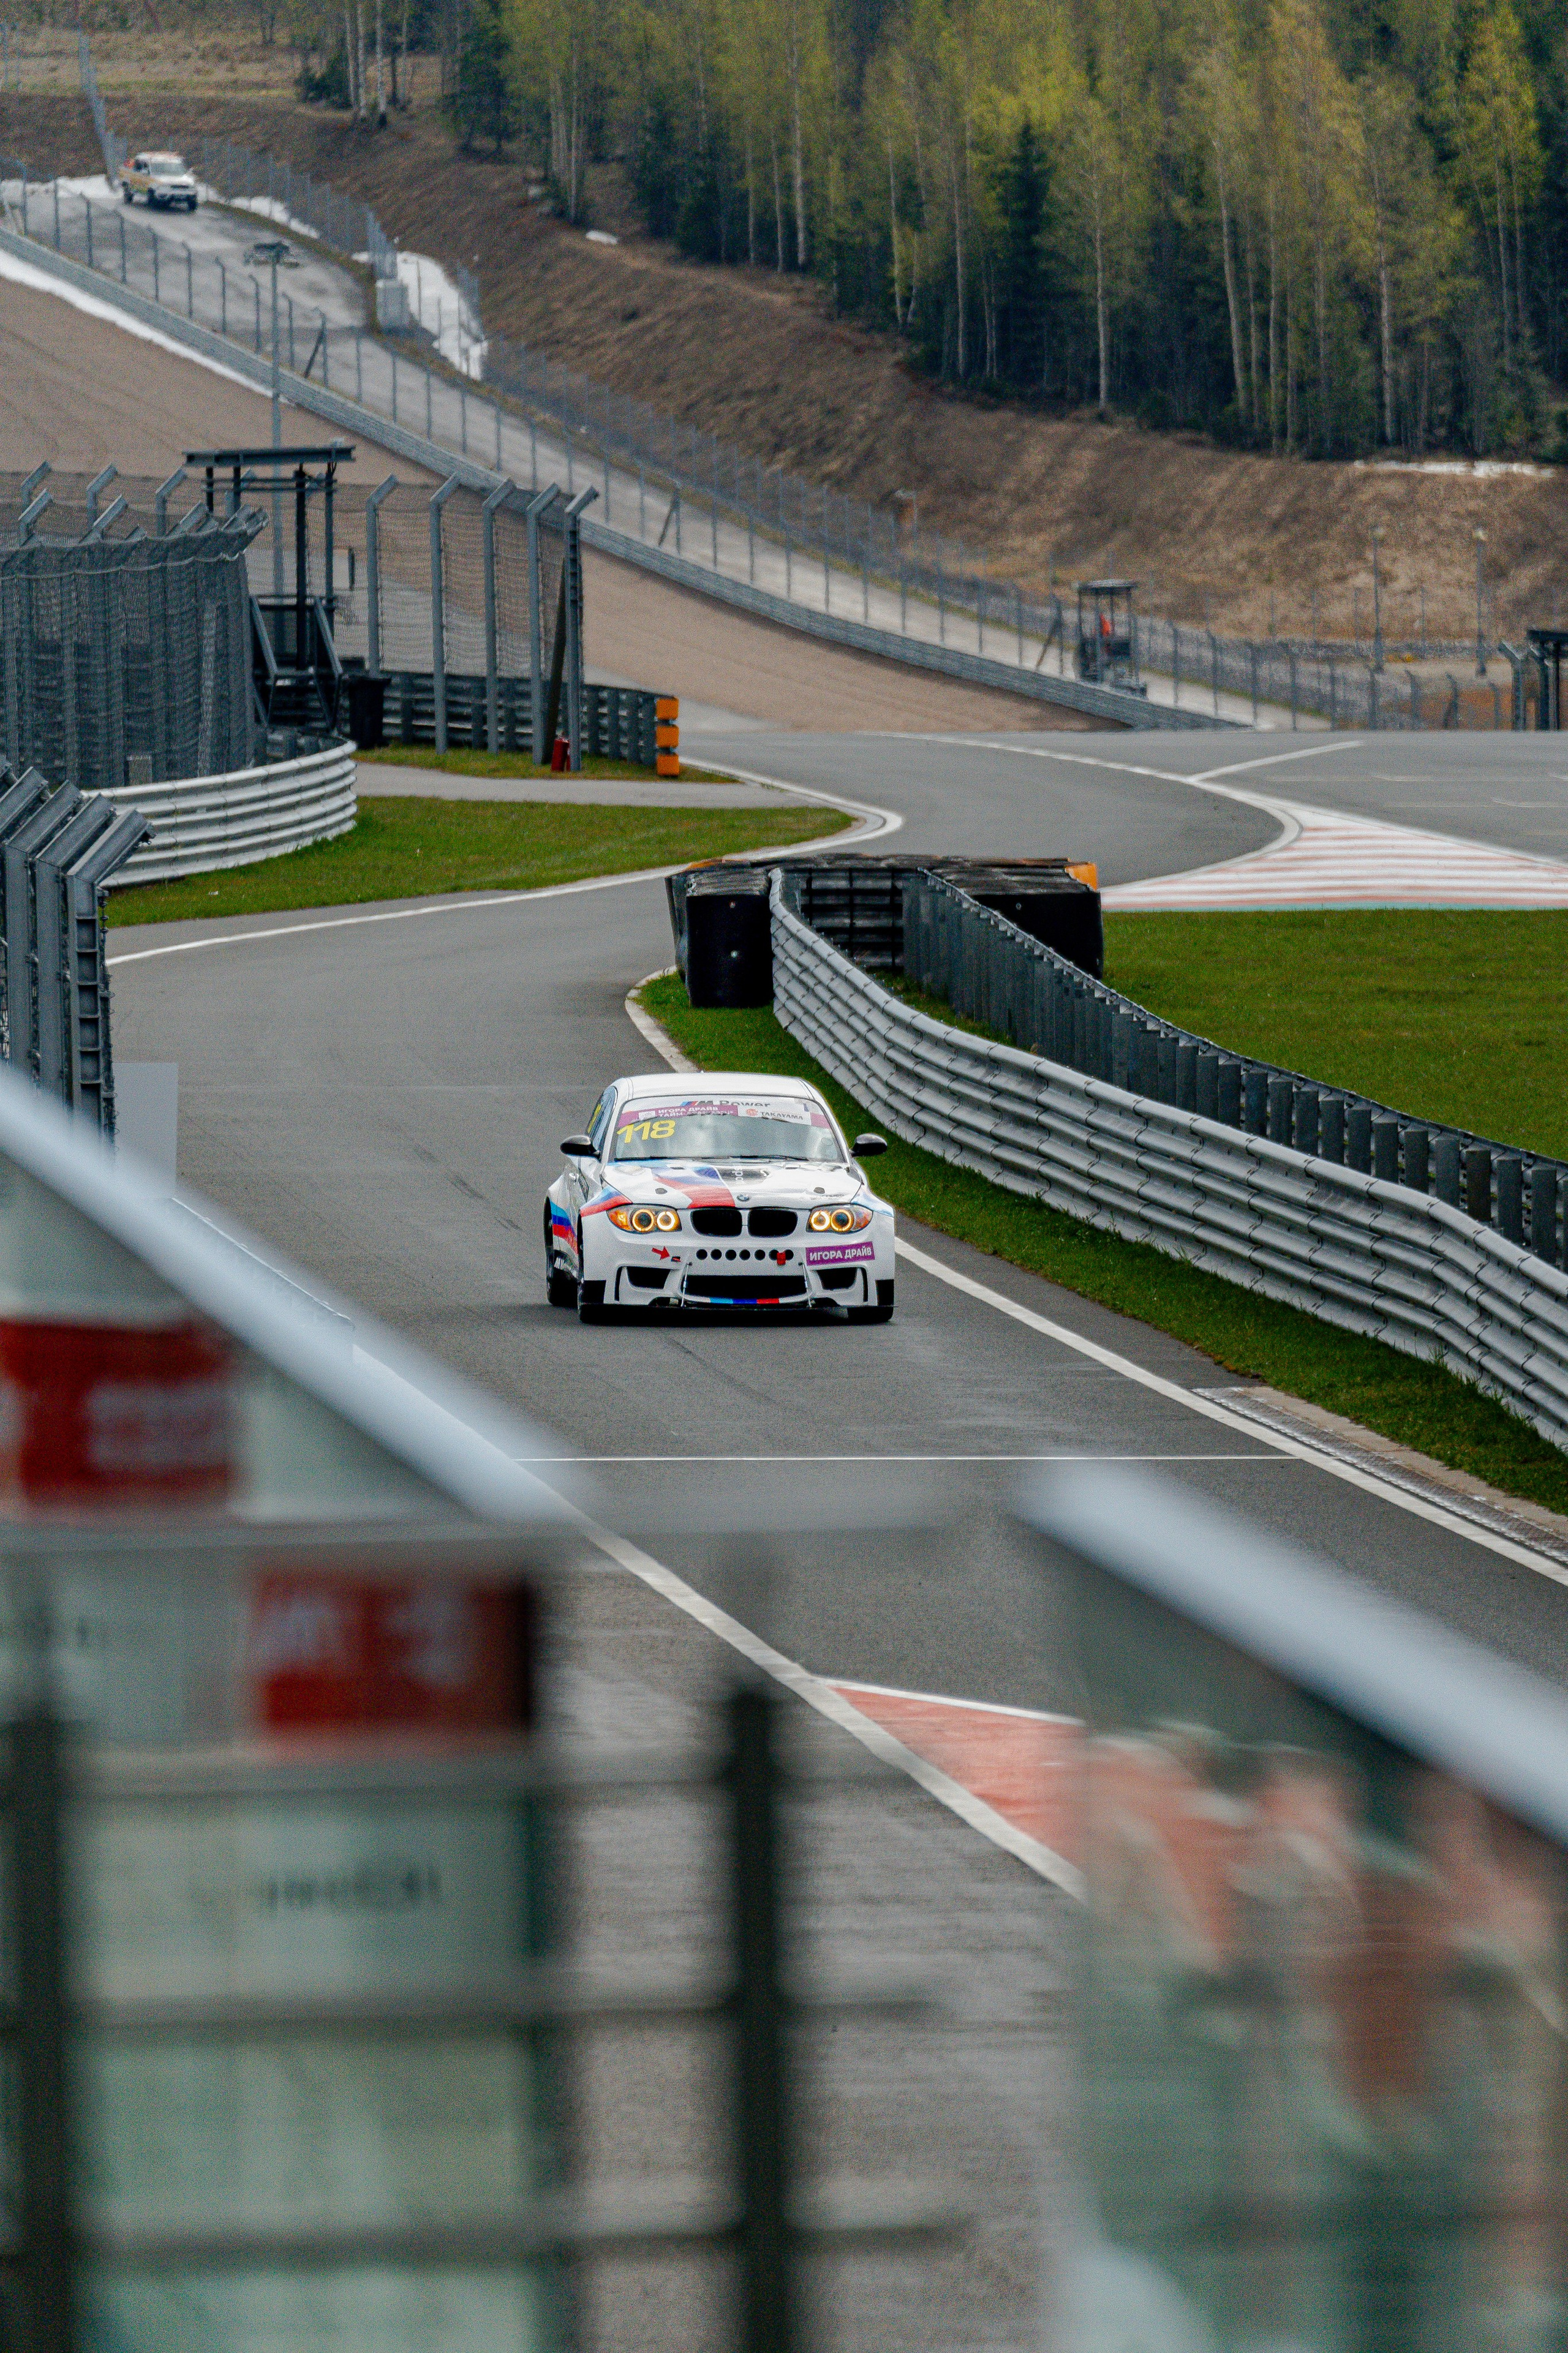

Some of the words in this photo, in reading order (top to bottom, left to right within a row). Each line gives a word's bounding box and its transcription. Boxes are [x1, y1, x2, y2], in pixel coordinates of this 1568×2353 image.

[760, 1111, 804, 1120] TAKAYAMA
[616, 1120, 676, 1144] 118
[810, 1250, 843, 1261] ИГОРА
[844, 1245, 872, 1260] ДРАЙВ
